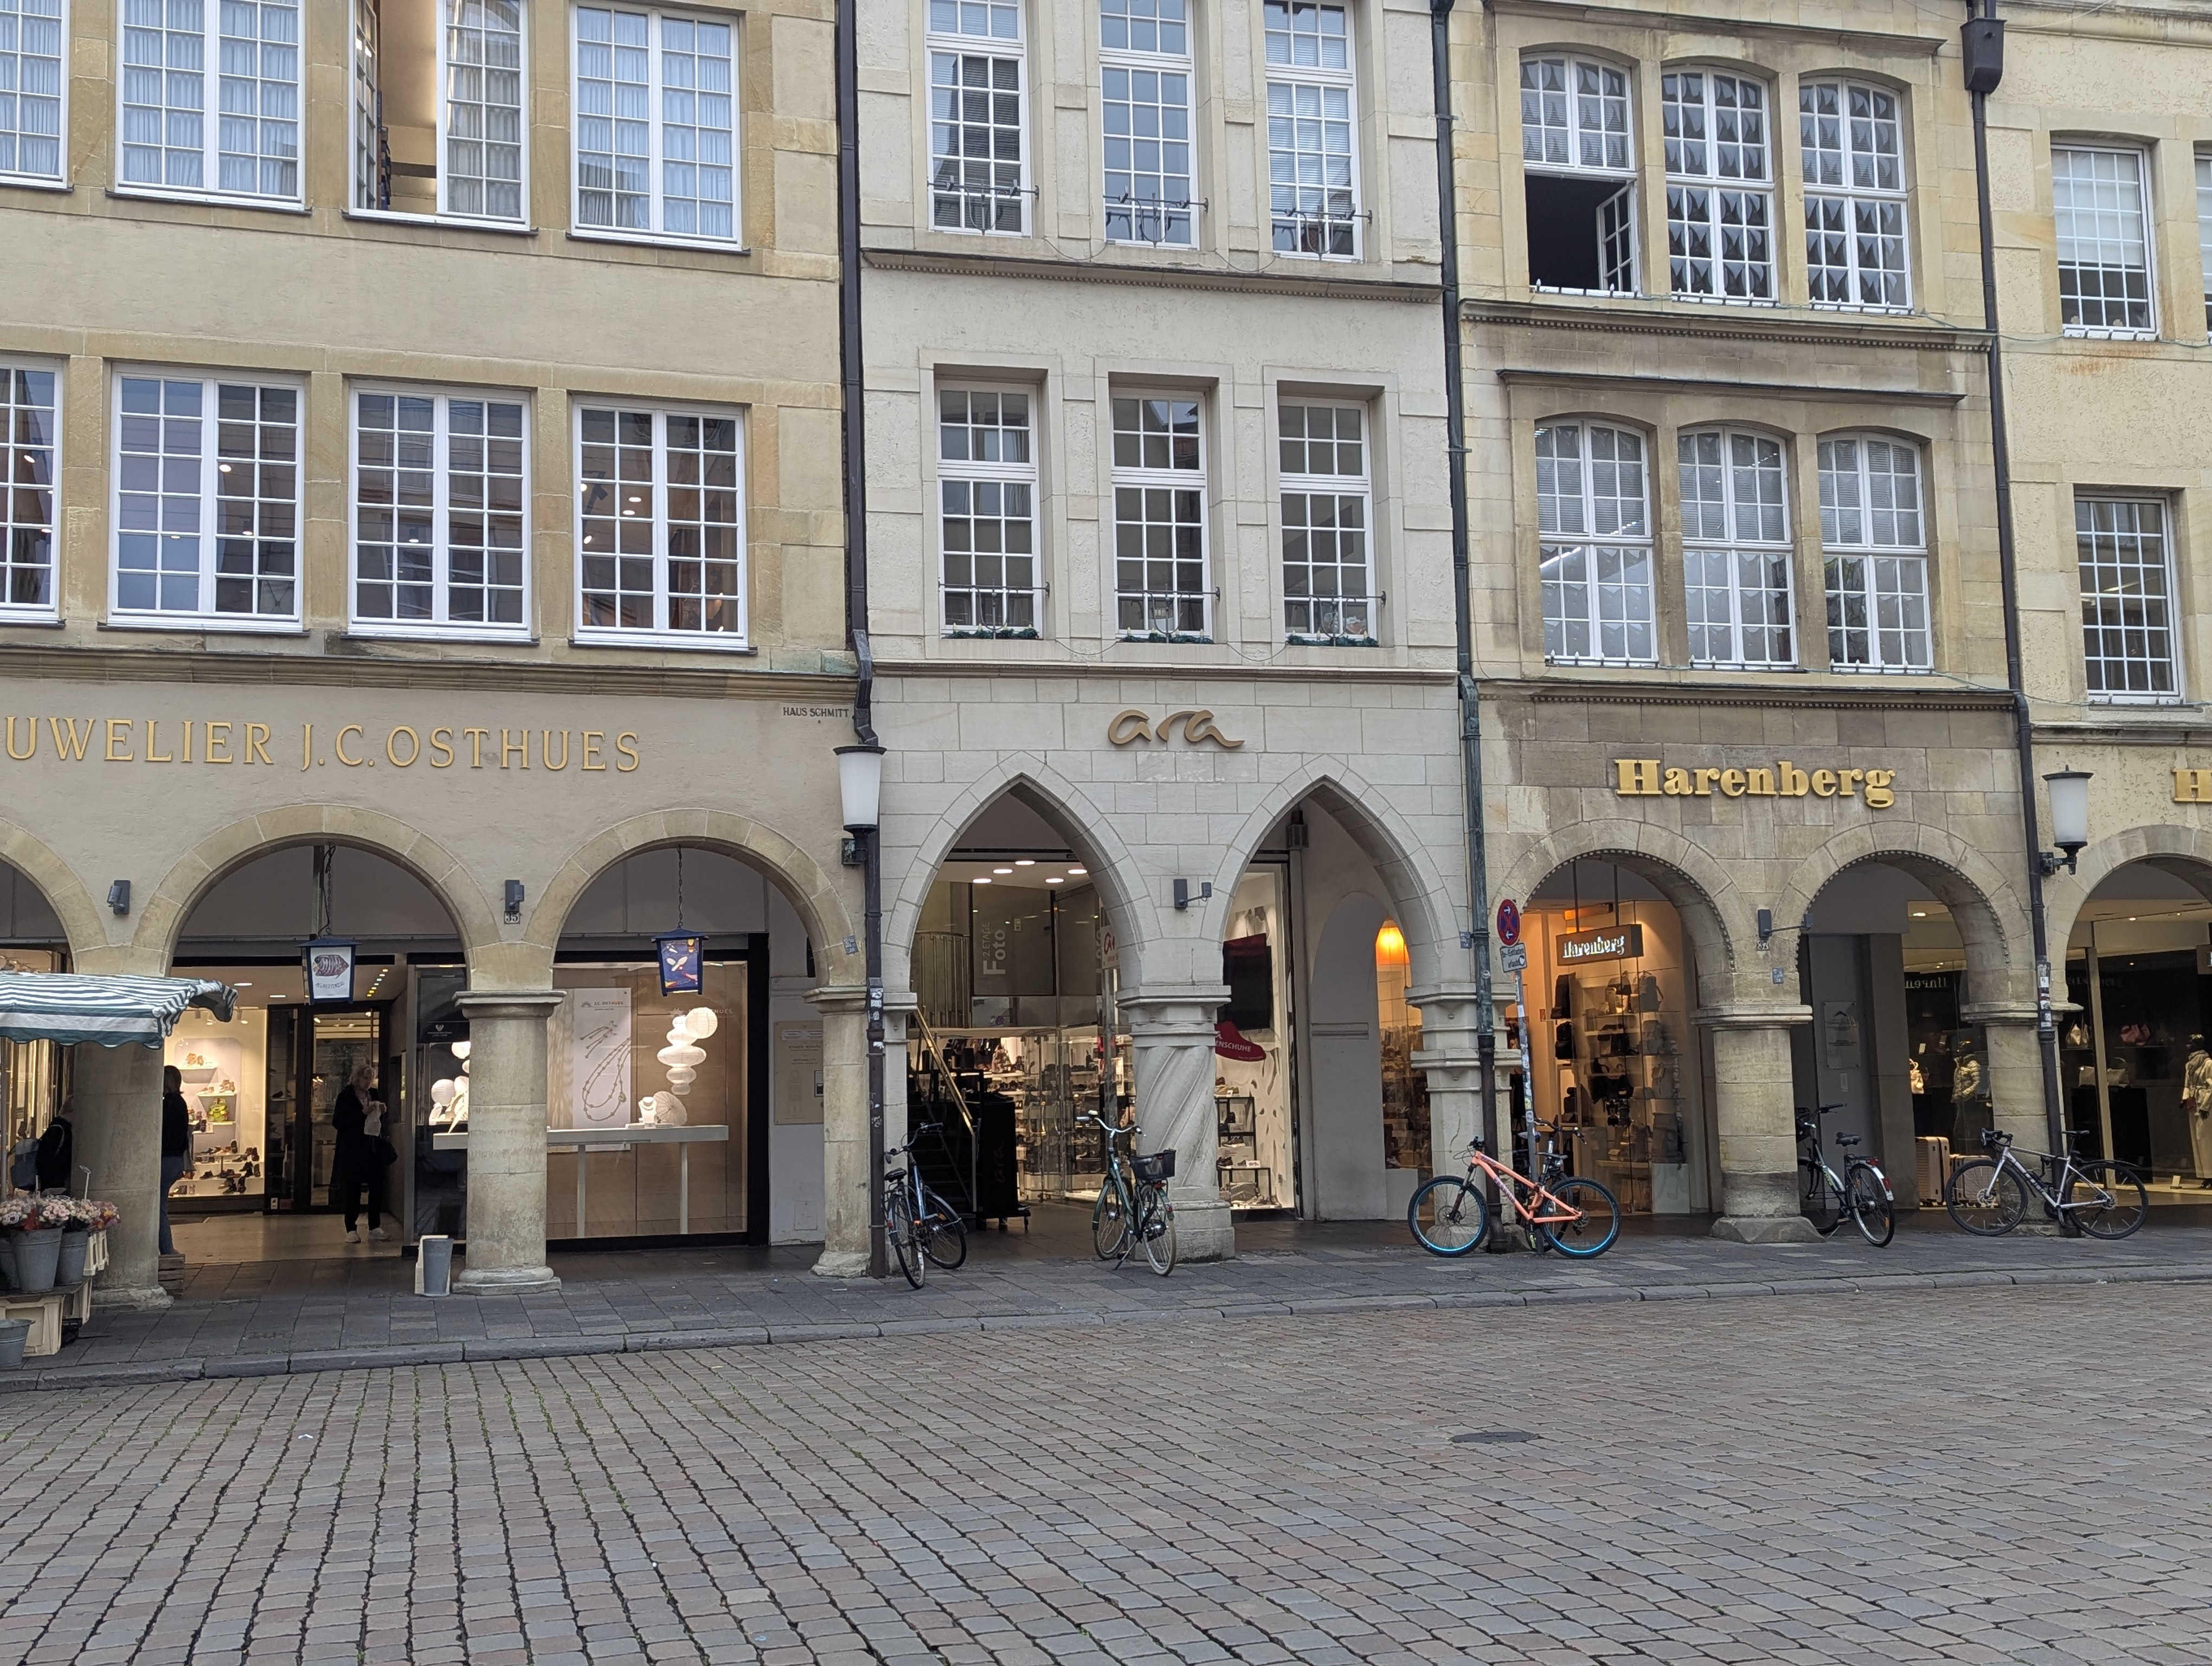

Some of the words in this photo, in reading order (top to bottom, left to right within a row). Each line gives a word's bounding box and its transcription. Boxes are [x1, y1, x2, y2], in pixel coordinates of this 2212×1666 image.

[783, 707, 808, 716] HAUS
[809, 708, 850, 717] SCHMITT
[1108, 709, 1245, 748] ara
[5, 716, 274, 765] UWELIER
[1613, 759, 1896, 809] Harenberg
[504, 909, 518, 922] 35
[982, 922, 991, 949] ETAGE
[982, 929, 1006, 975] Foto
